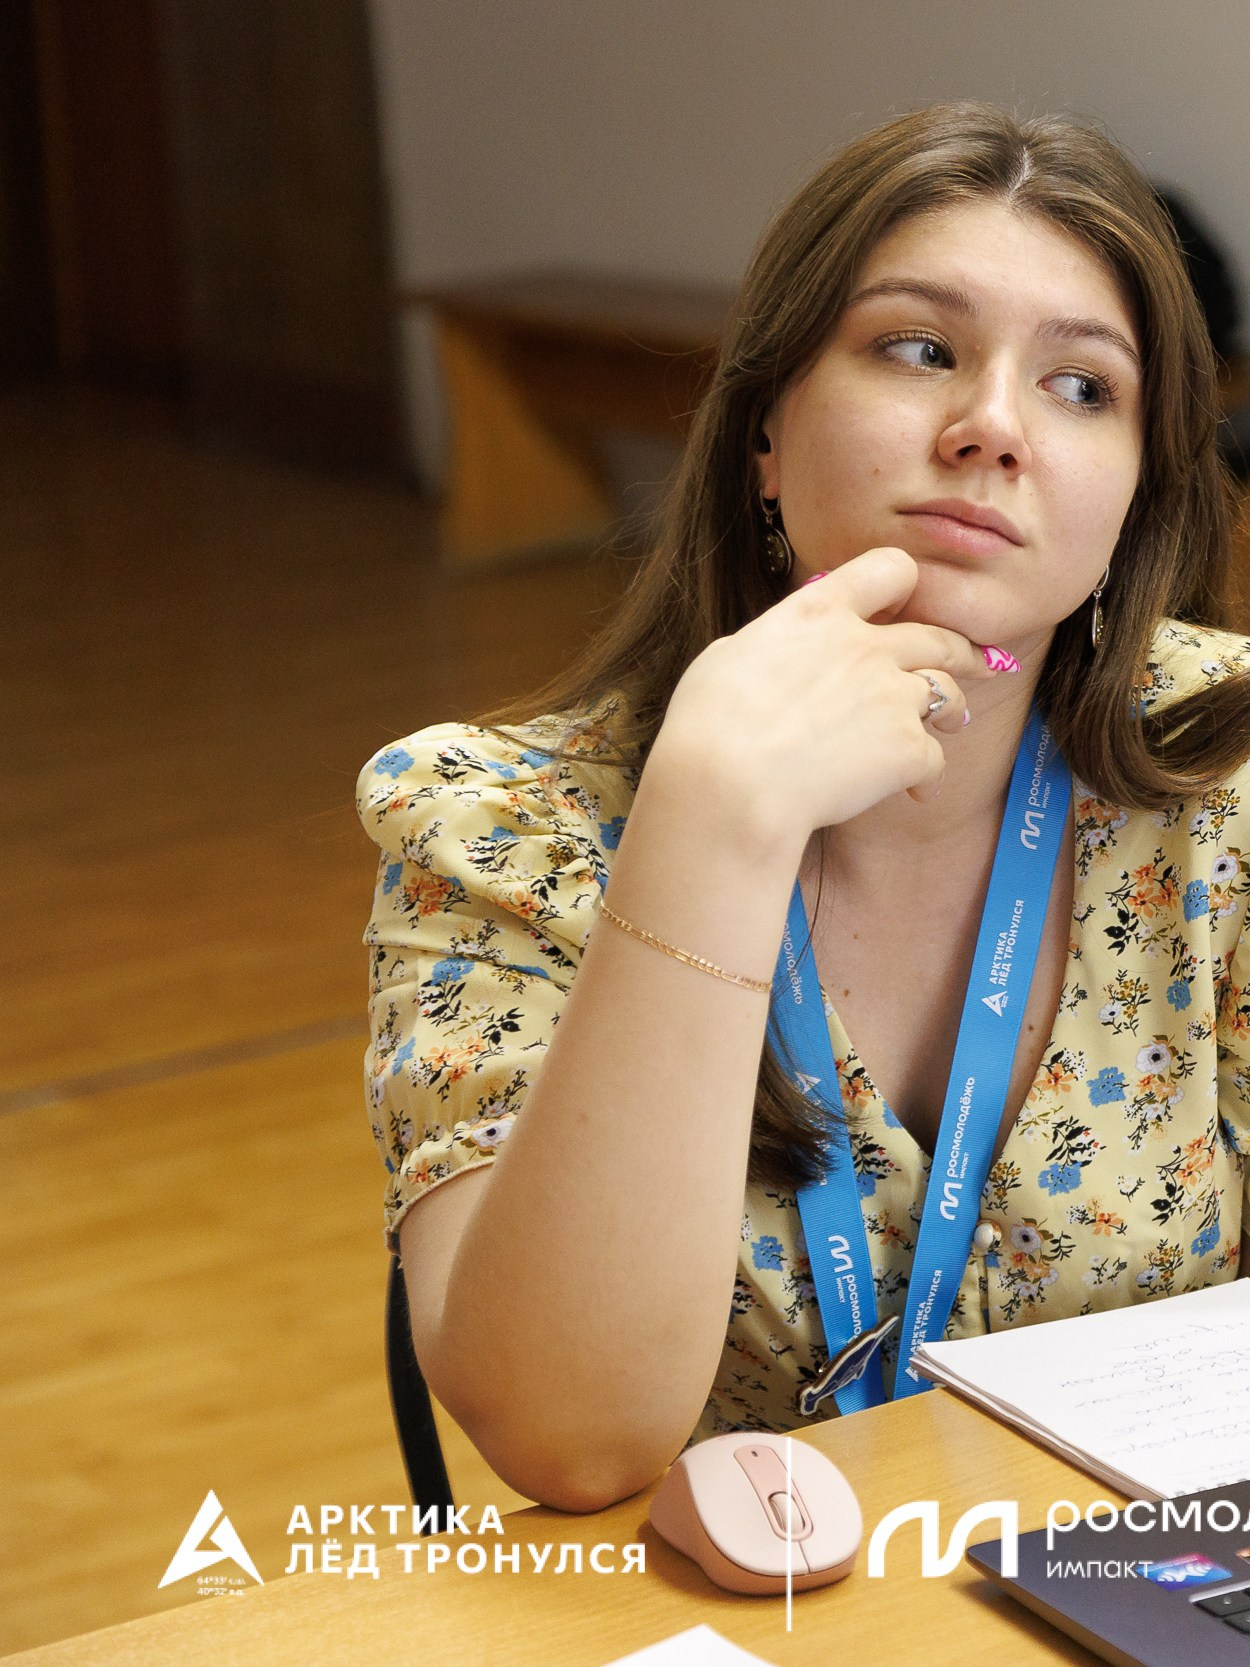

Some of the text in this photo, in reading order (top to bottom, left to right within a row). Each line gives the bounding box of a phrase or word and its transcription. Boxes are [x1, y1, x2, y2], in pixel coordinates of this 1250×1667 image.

[1028, 723, 1052, 808] росмолодё
[989, 932, 1008, 985] АРКТИКА
[1003, 899, 1025, 960] ТРОНУЛСЯ
[947, 1077, 975, 1178] росмолодёжь
[842, 1273, 862, 1336] росмоло
[910, 1301, 926, 1354] АРКТИКА
[920, 1269, 942, 1328] ТРОНУЛСЯ
